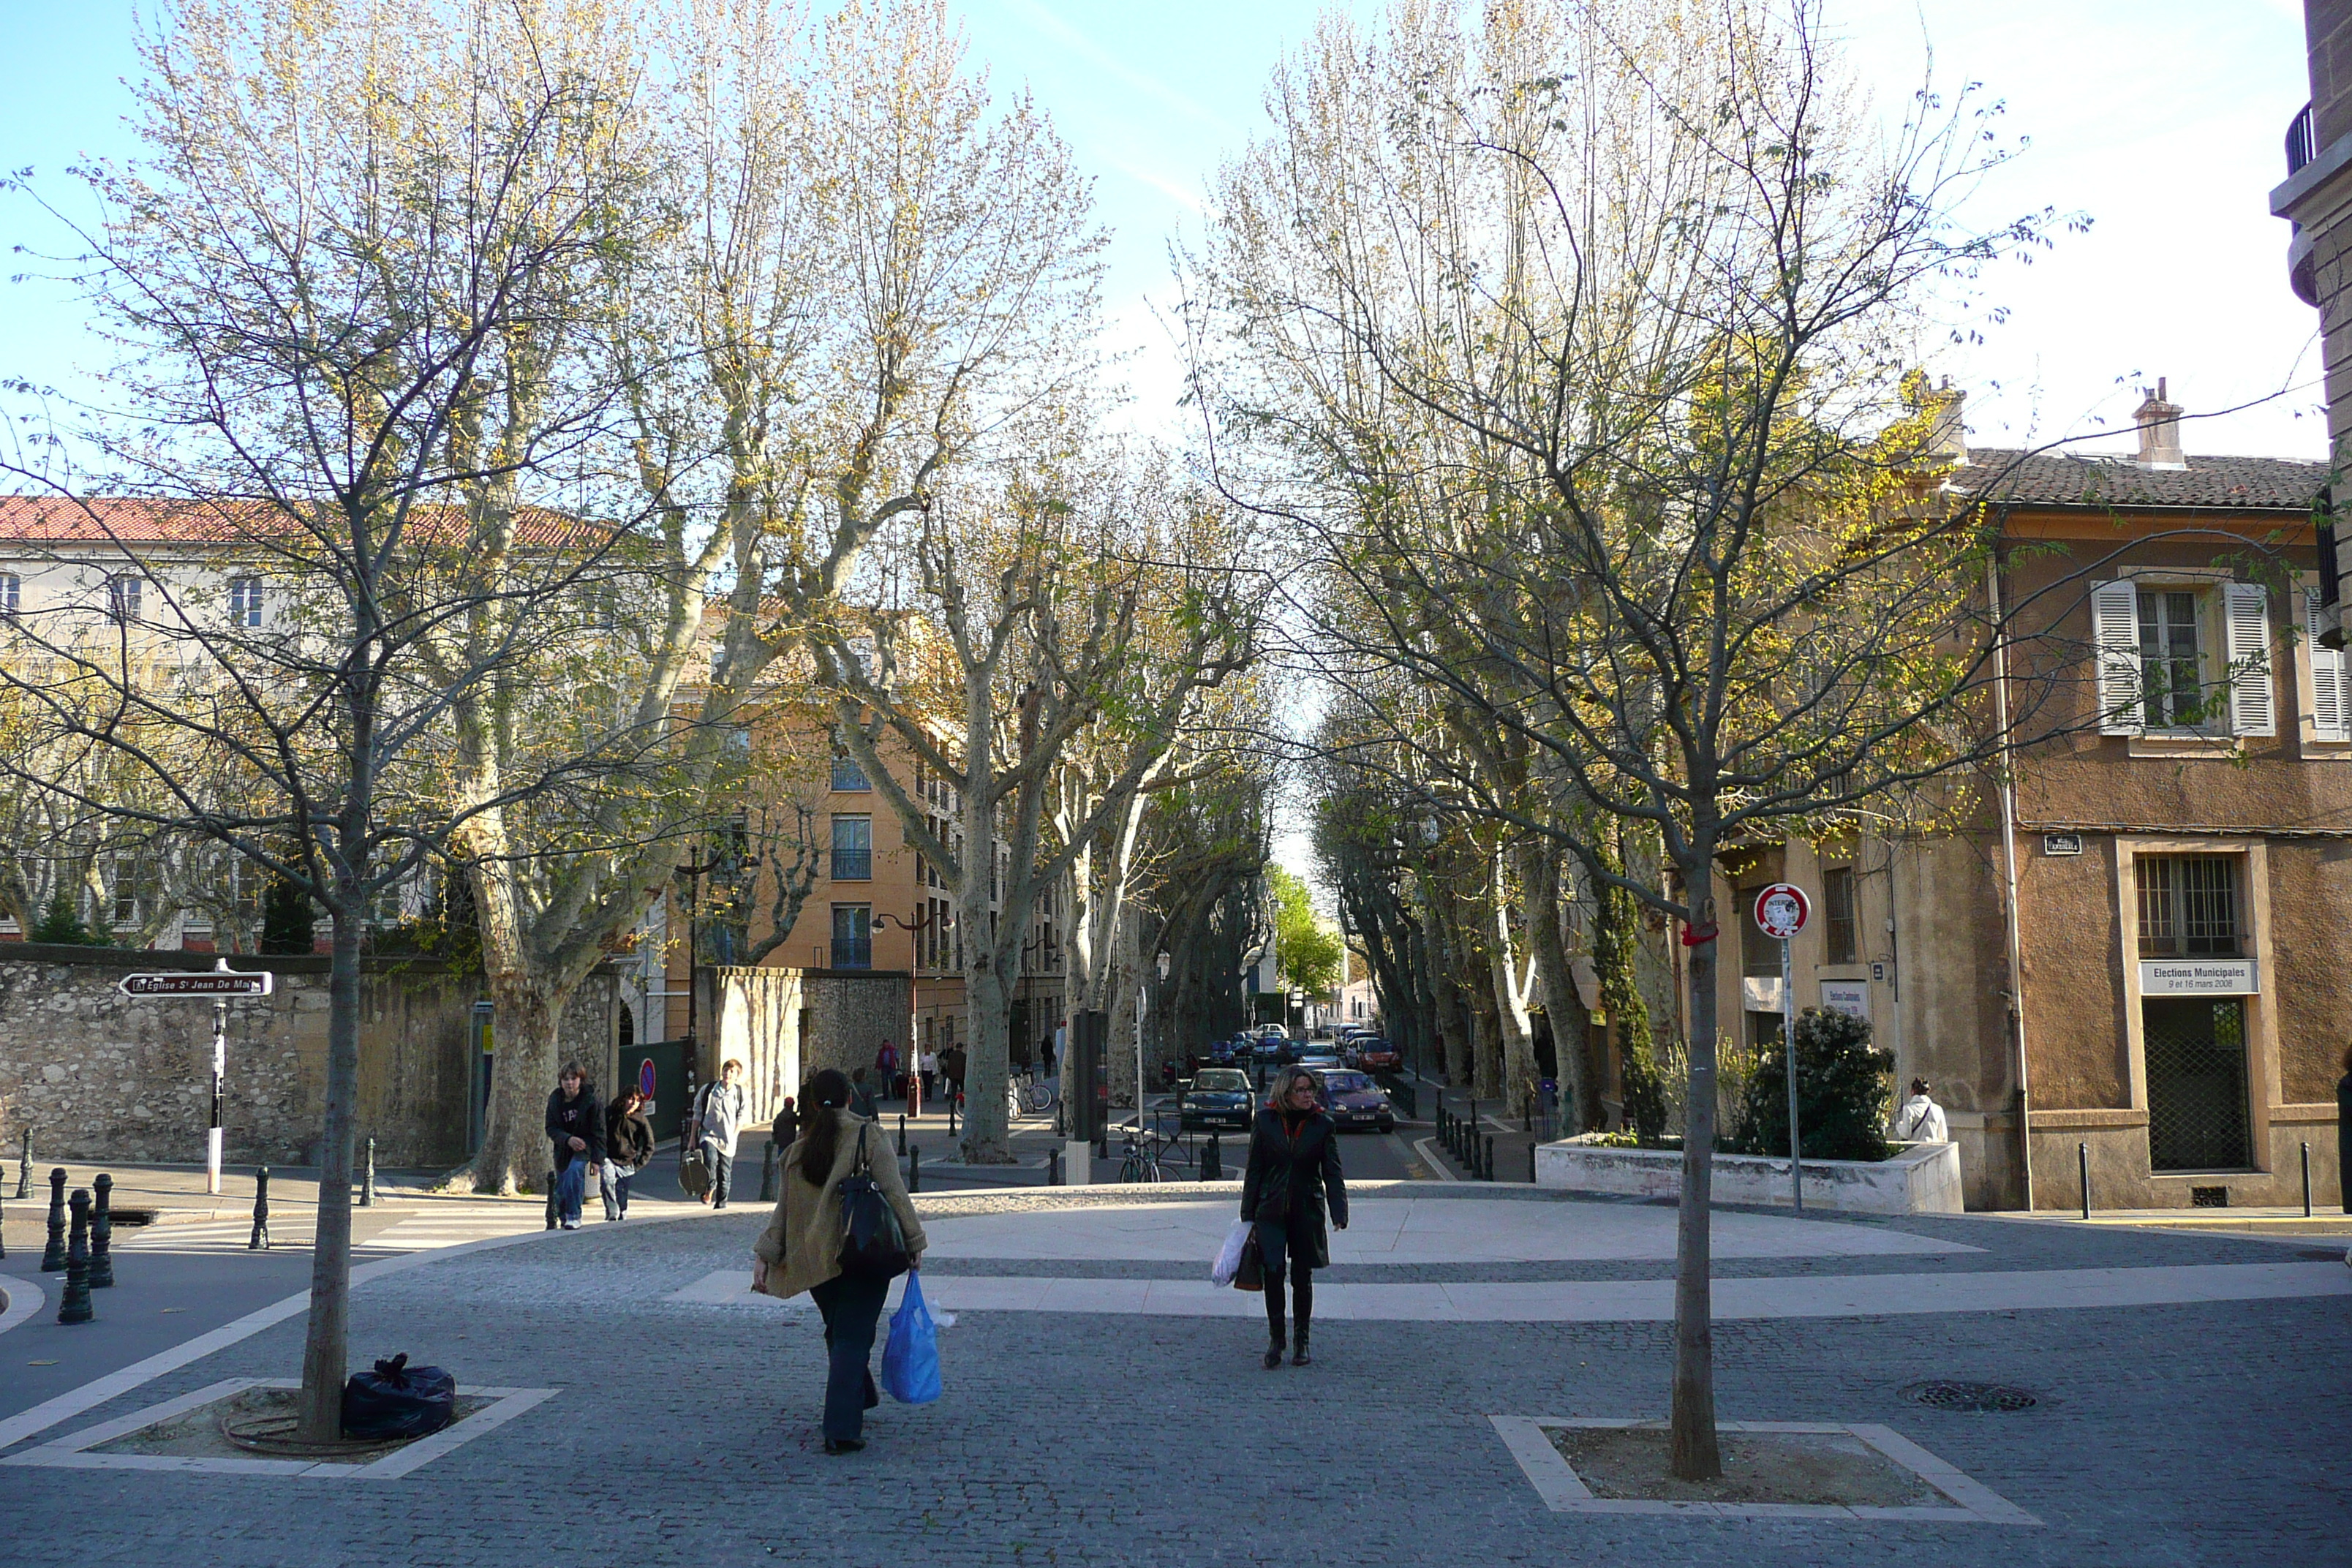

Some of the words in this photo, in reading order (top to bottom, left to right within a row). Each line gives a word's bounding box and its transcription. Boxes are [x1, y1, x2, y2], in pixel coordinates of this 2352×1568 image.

[2154, 968, 2192, 978] Elections
[2195, 967, 2245, 979] Municipales
[192, 980, 214, 989] Jean
[217, 979, 230, 989] De
[2168, 980, 2174, 988] 9
[2175, 980, 2183, 988] et
[2185, 979, 2193, 988] 16
[2195, 980, 2213, 988] mars
[2215, 979, 2233, 988] 2008
